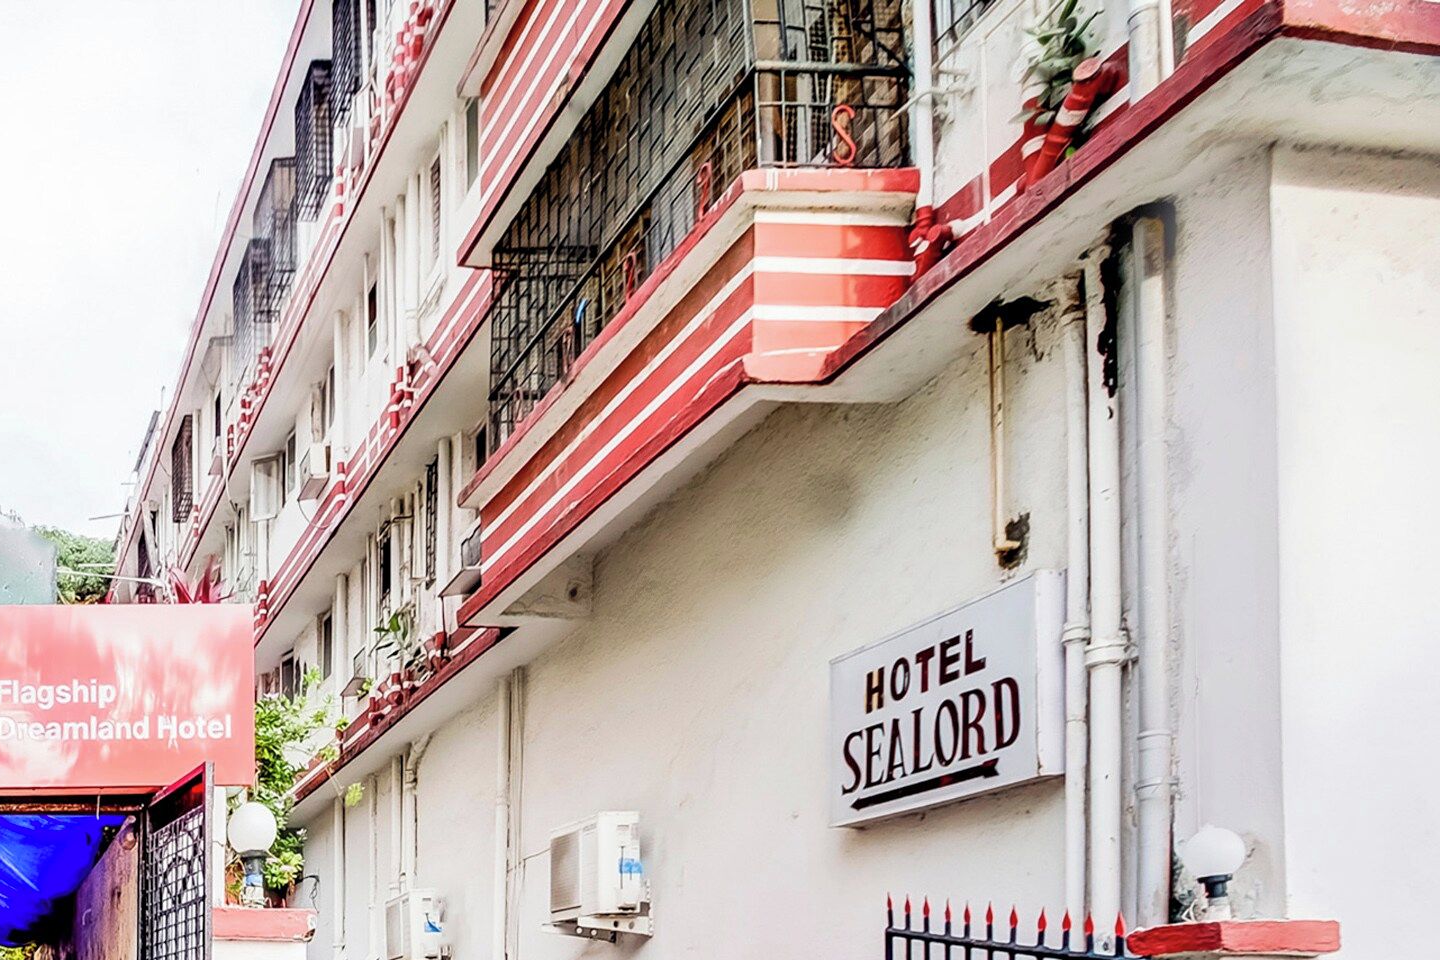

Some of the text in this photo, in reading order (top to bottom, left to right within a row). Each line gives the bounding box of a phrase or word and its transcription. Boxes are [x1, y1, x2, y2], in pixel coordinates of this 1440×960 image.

[864, 628, 987, 715] HOTEL
[157, 714, 233, 740] Hotel
[841, 676, 1021, 796] SEALORD
